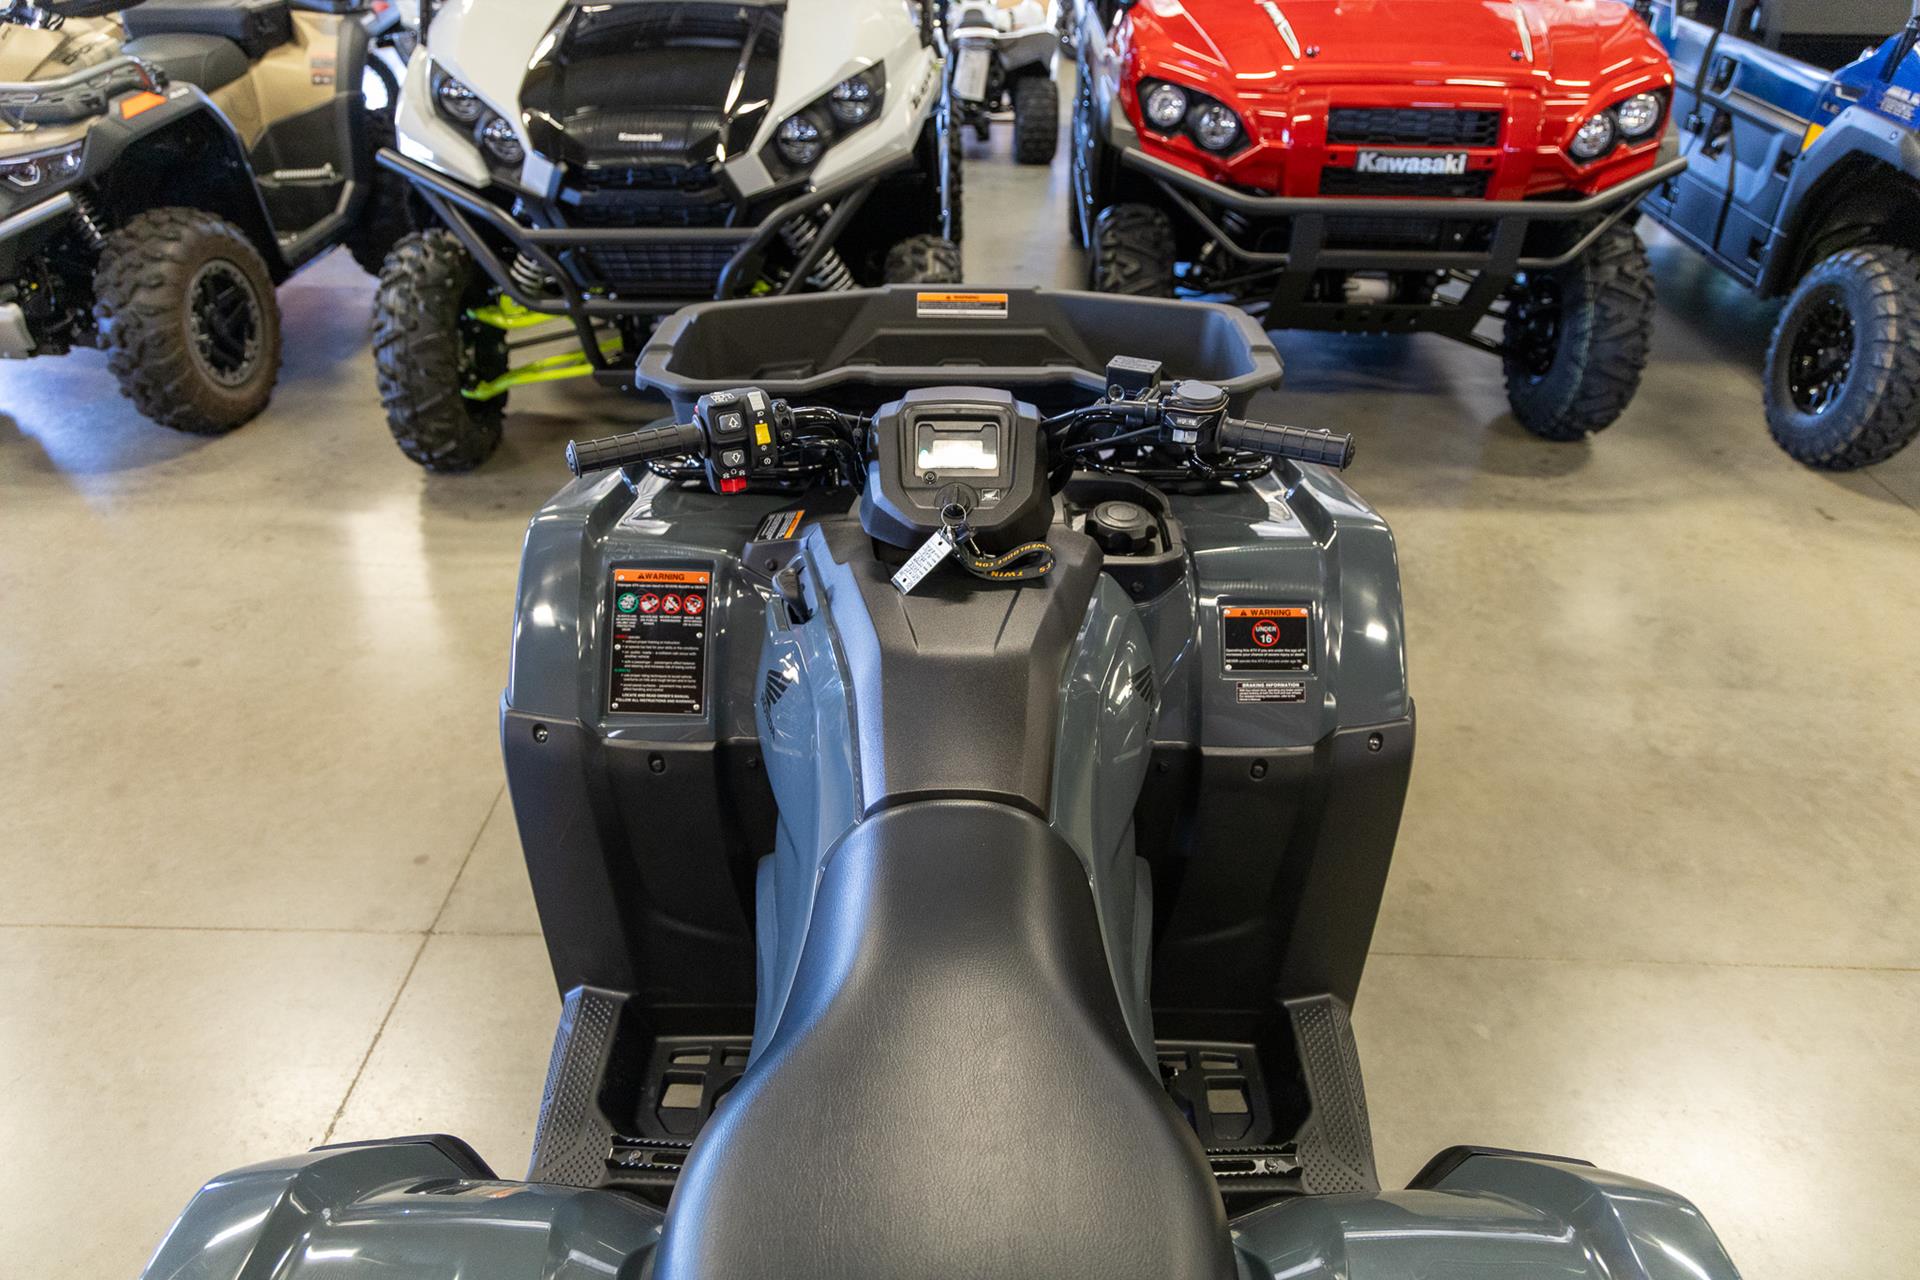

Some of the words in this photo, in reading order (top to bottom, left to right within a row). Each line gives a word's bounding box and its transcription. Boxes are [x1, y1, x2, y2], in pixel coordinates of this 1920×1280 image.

[618, 132, 663, 141] Kawasaki
[1357, 151, 1467, 174] Kawasaki
[645, 573, 685, 581] WARNING
[1250, 609, 1292, 617] WARNING
[1260, 634, 1273, 643] 16
